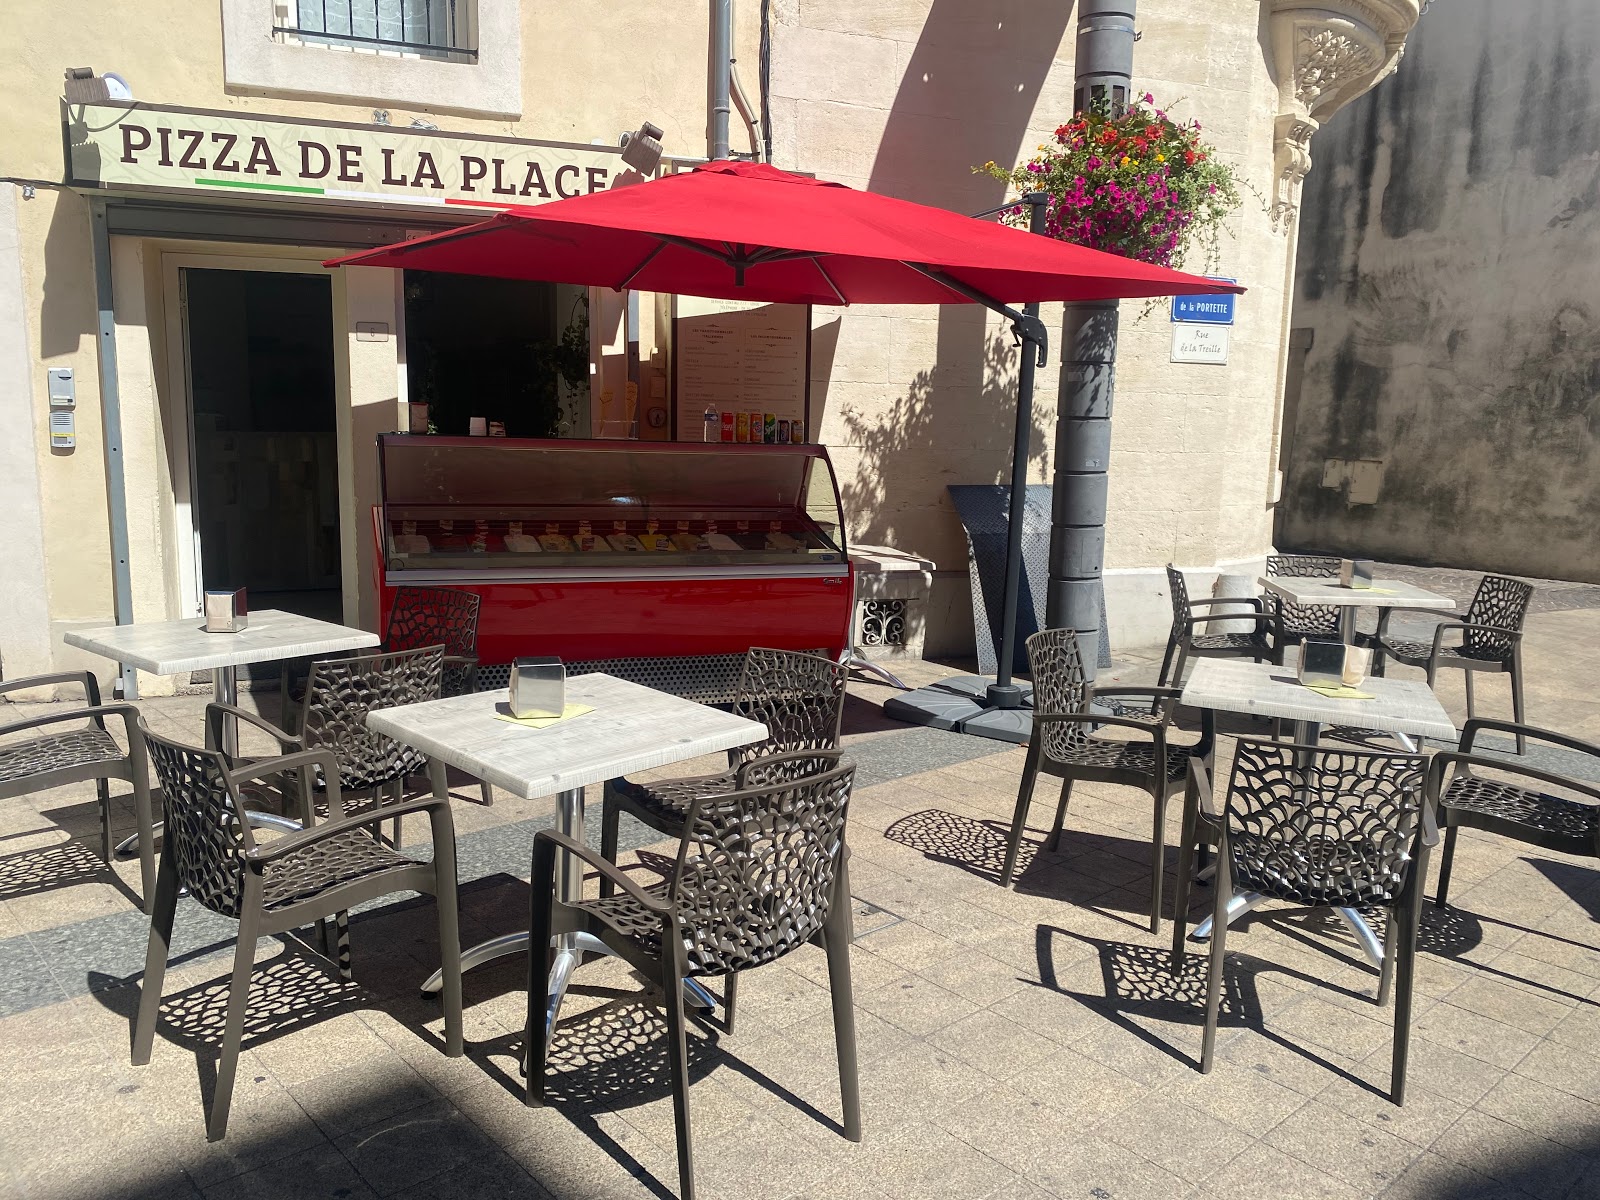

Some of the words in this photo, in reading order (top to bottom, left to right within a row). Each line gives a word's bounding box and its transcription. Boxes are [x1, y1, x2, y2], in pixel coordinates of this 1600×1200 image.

[118, 124, 282, 177] PIZZA
[298, 141, 364, 183] DE
[381, 149, 445, 190] LA
[460, 156, 608, 200] PLACE
[1180, 302, 1186, 311] de
[1189, 302, 1194, 311] la
[1197, 303, 1228, 313] PORTETTE
[1195, 330, 1209, 339] Rue
[1180, 343, 1188, 354] de
[1189, 344, 1197, 352] la
[1199, 344, 1221, 353] Treille
